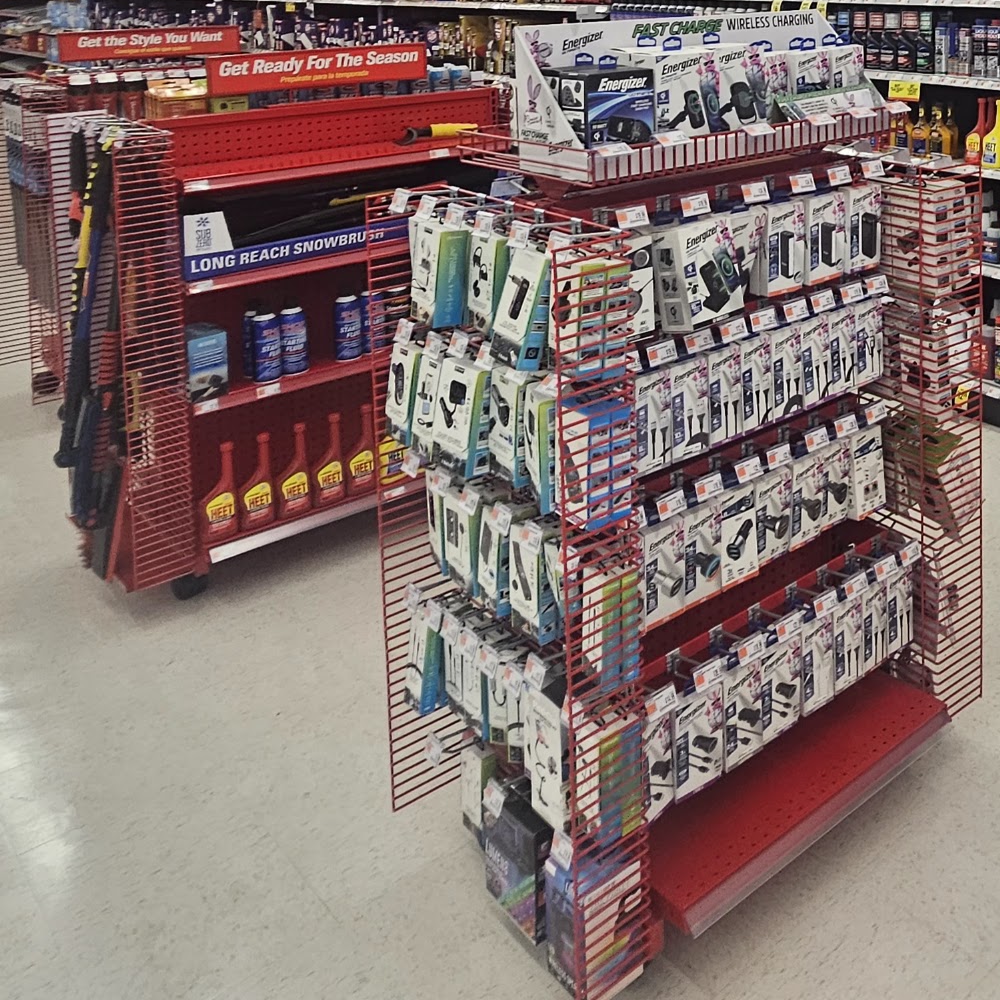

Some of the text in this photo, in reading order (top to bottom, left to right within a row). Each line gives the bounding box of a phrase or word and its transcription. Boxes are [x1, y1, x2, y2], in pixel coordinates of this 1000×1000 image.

[632, 13, 814, 39] FAST CHARGE WIRELESS CHARGING
[77, 31, 223, 48] Get the Style You Want
[562, 31, 603, 50] Energizer
[219, 51, 419, 77] Get Ready For The Season
[662, 55, 702, 75] Energizer
[598, 76, 648, 92] Energizer
[853, 192, 873, 205] Energizer
[812, 200, 833, 215] Energizer
[771, 210, 795, 224] Energizer
[196, 228, 211, 239] SUB
[686, 224, 719, 249] Energizer
[191, 256, 235, 273] LONG
[240, 245, 289, 265] REACH
[711, 353, 735, 370] Energizer
[674, 365, 700, 383] Energizer
[639, 377, 665, 394] Energizer
[354, 462, 373, 477] HEET
[321, 472, 342, 488] HEET
[287, 483, 307, 499] HEET
[249, 494, 270, 510] HEET
[211, 504, 233, 521] HEET
